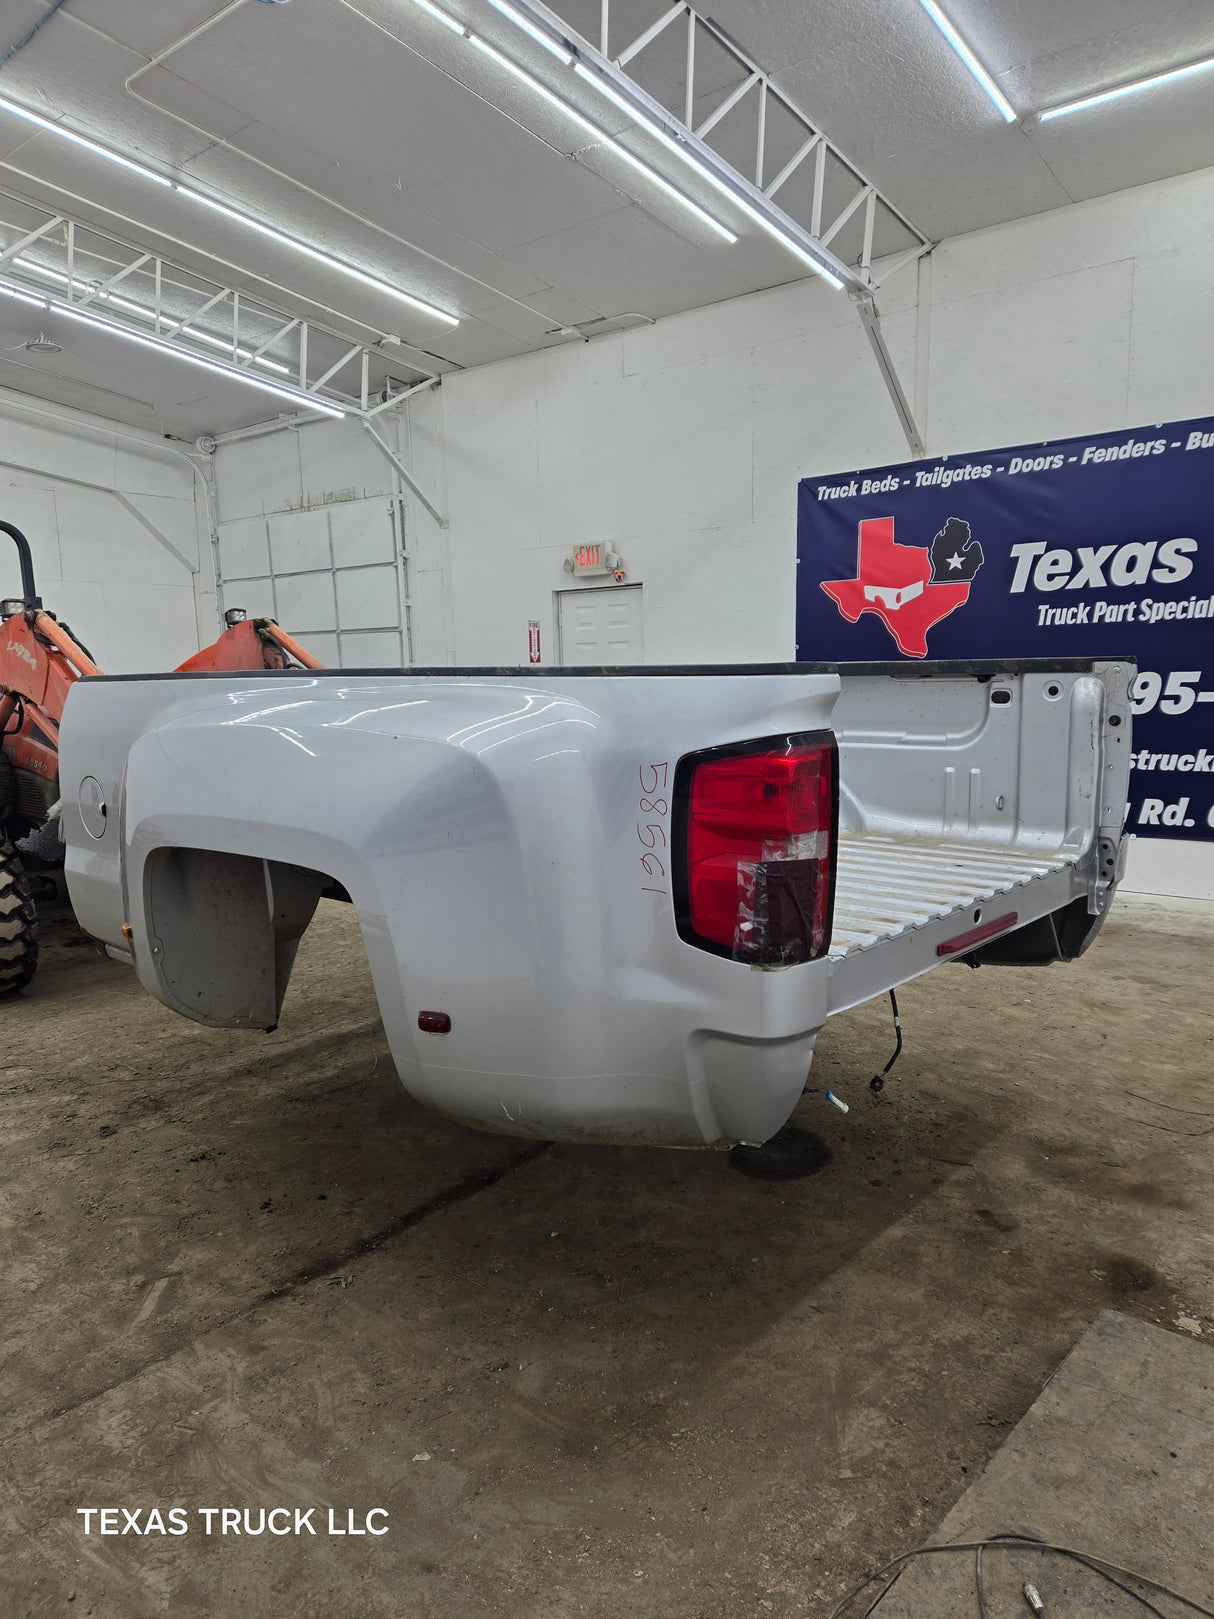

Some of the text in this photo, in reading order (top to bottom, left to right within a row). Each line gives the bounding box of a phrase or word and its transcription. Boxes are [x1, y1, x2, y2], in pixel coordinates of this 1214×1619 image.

[817, 481, 859, 501] Truck
[861, 475, 900, 495] Beds
[915, 464, 993, 488] Tailgates
[1008, 454, 1065, 475] Doors
[1080, 439, 1167, 465] Fenders
[579, 545, 600, 566] EXIT
[1009, 537, 1199, 594] Texas
[1038, 602, 1091, 626] Truck
[1092, 601, 1138, 624] Part
[637, 762, 668, 894] 58561
[1138, 797, 1195, 827] Rd.
